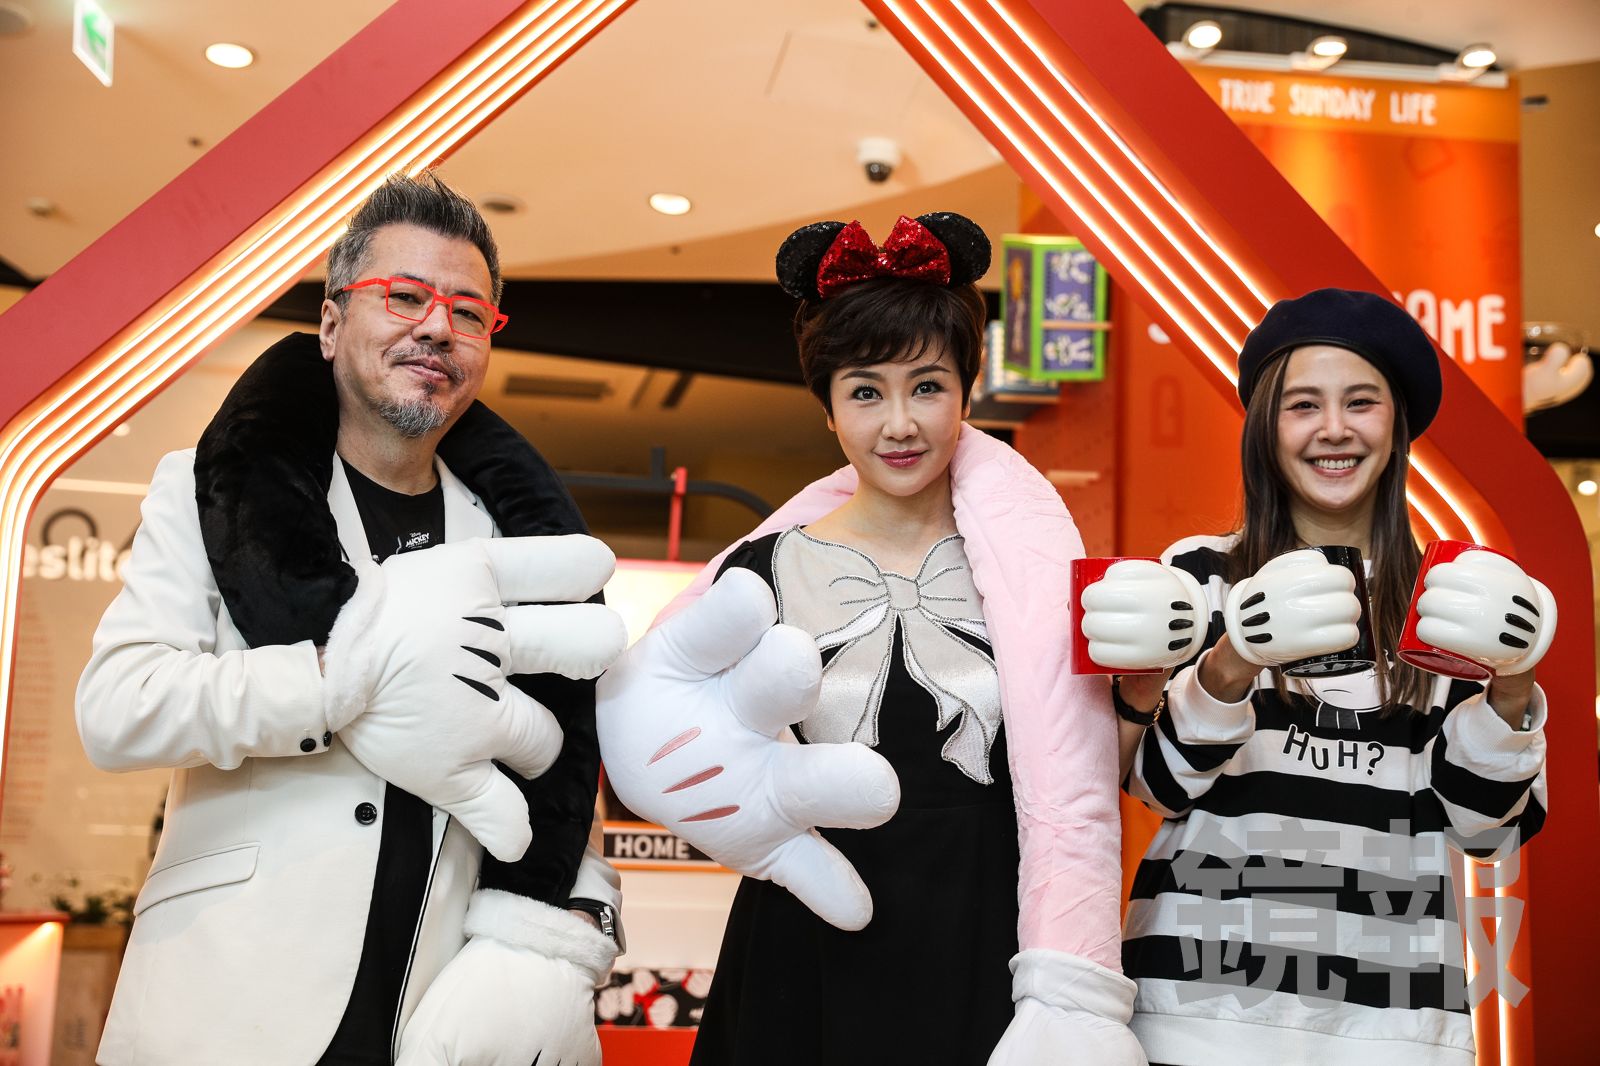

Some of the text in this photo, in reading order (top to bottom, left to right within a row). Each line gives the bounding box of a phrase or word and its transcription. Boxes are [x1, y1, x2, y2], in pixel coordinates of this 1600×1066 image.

[1219, 78, 1275, 113] TRUE
[1390, 92, 1437, 125] LIFE
[1392, 289, 1507, 364] AME
[1282, 724, 1385, 776] HUH?
[614, 834, 690, 859] HOME
